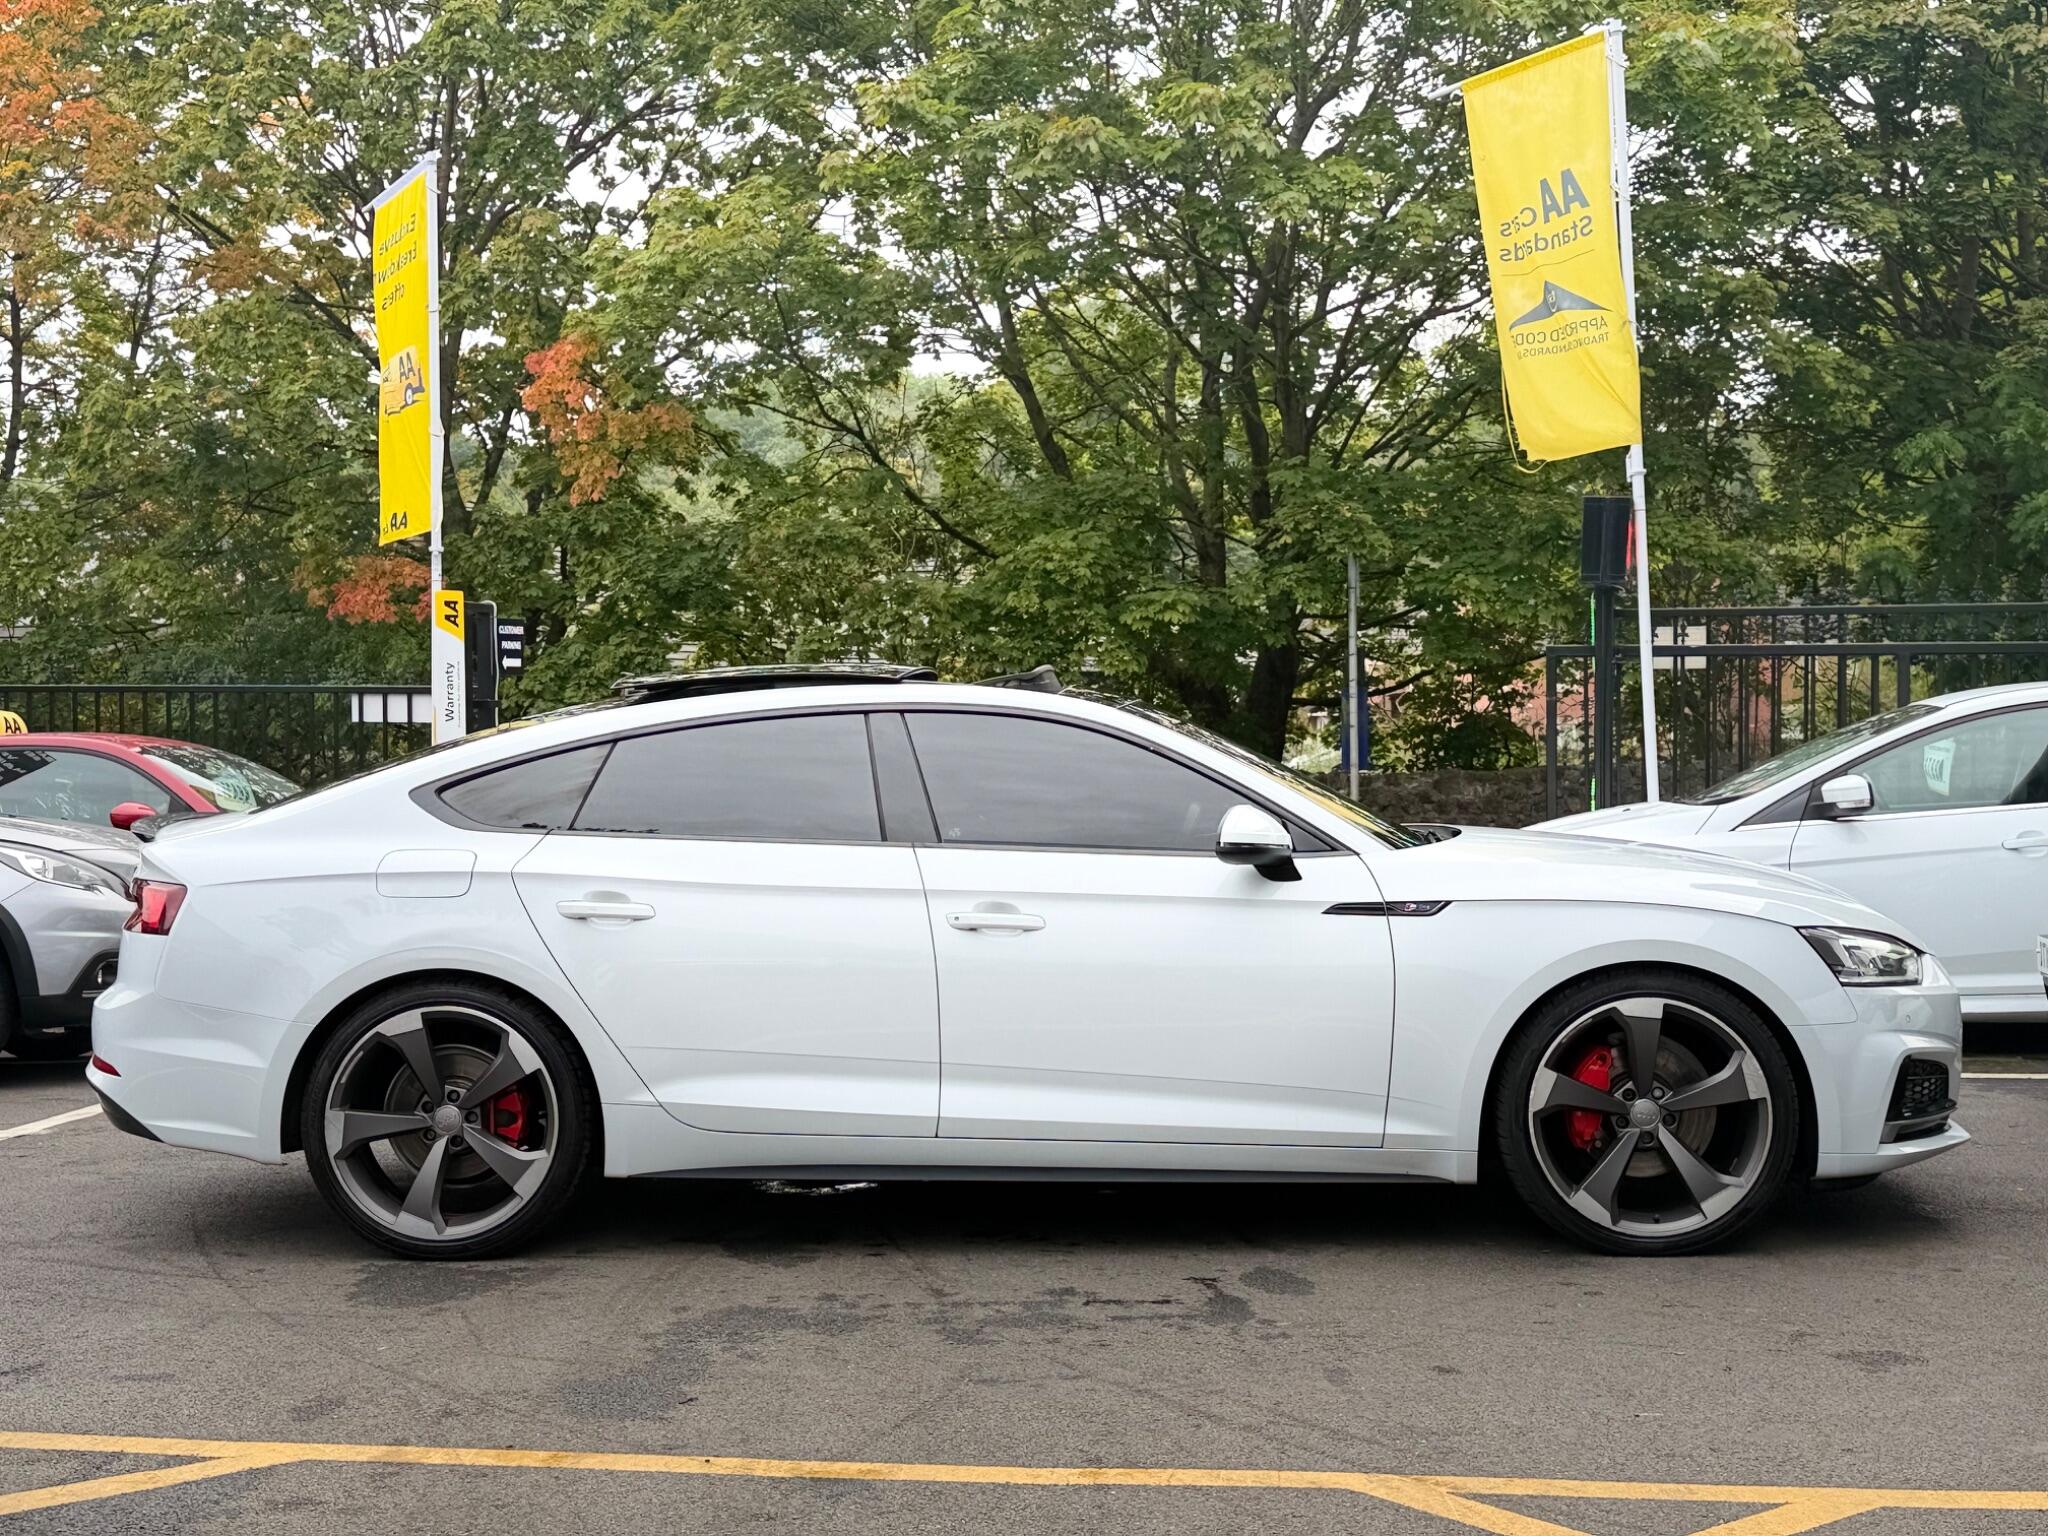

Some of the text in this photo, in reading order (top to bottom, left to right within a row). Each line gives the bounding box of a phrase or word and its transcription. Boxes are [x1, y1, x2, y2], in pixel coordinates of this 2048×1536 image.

[444, 600, 459, 628] AA
[445, 662, 456, 723] Warranty
[4, 716, 22, 734] AA
